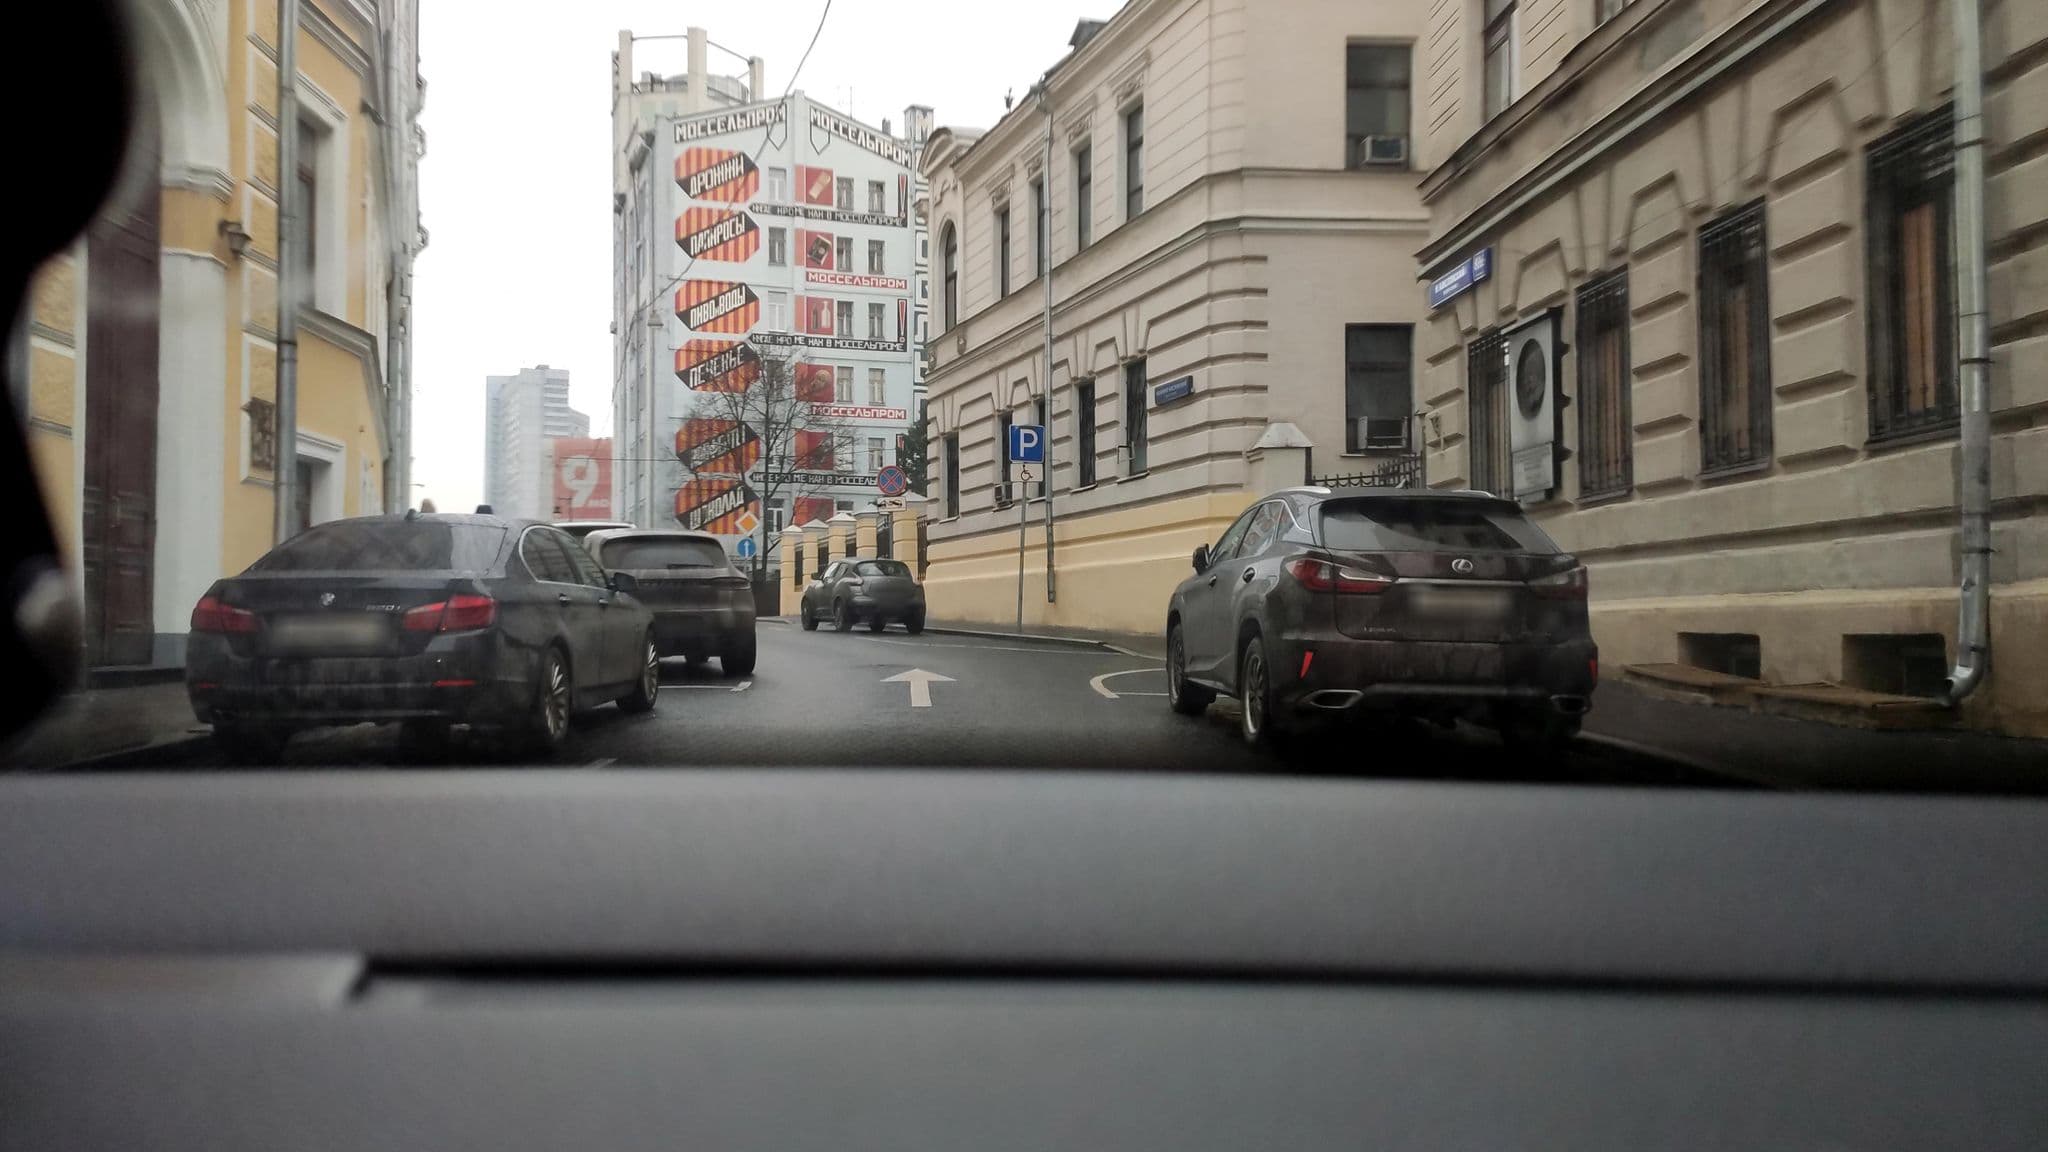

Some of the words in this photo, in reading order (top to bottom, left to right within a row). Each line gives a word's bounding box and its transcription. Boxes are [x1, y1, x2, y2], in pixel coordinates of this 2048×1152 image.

[675, 104, 787, 142] МОССЕЛЬПРОМ
[810, 105, 912, 169] МОССЕЛЬПРОМ
[690, 154, 744, 197] ДРОЖЖИ
[690, 212, 745, 255] ПАПИРОСЫ
[808, 272, 905, 289] МОССЕЛЬПРОМ
[690, 299, 715, 329] ПИВО
[719, 284, 746, 314] ВОДЫ
[690, 344, 745, 389] ПЕЧЕНЬЕ
[812, 406, 905, 419] МОССЕЛЬПРОМ
[1020, 428, 1038, 457] P
[562, 455, 599, 508] 9
